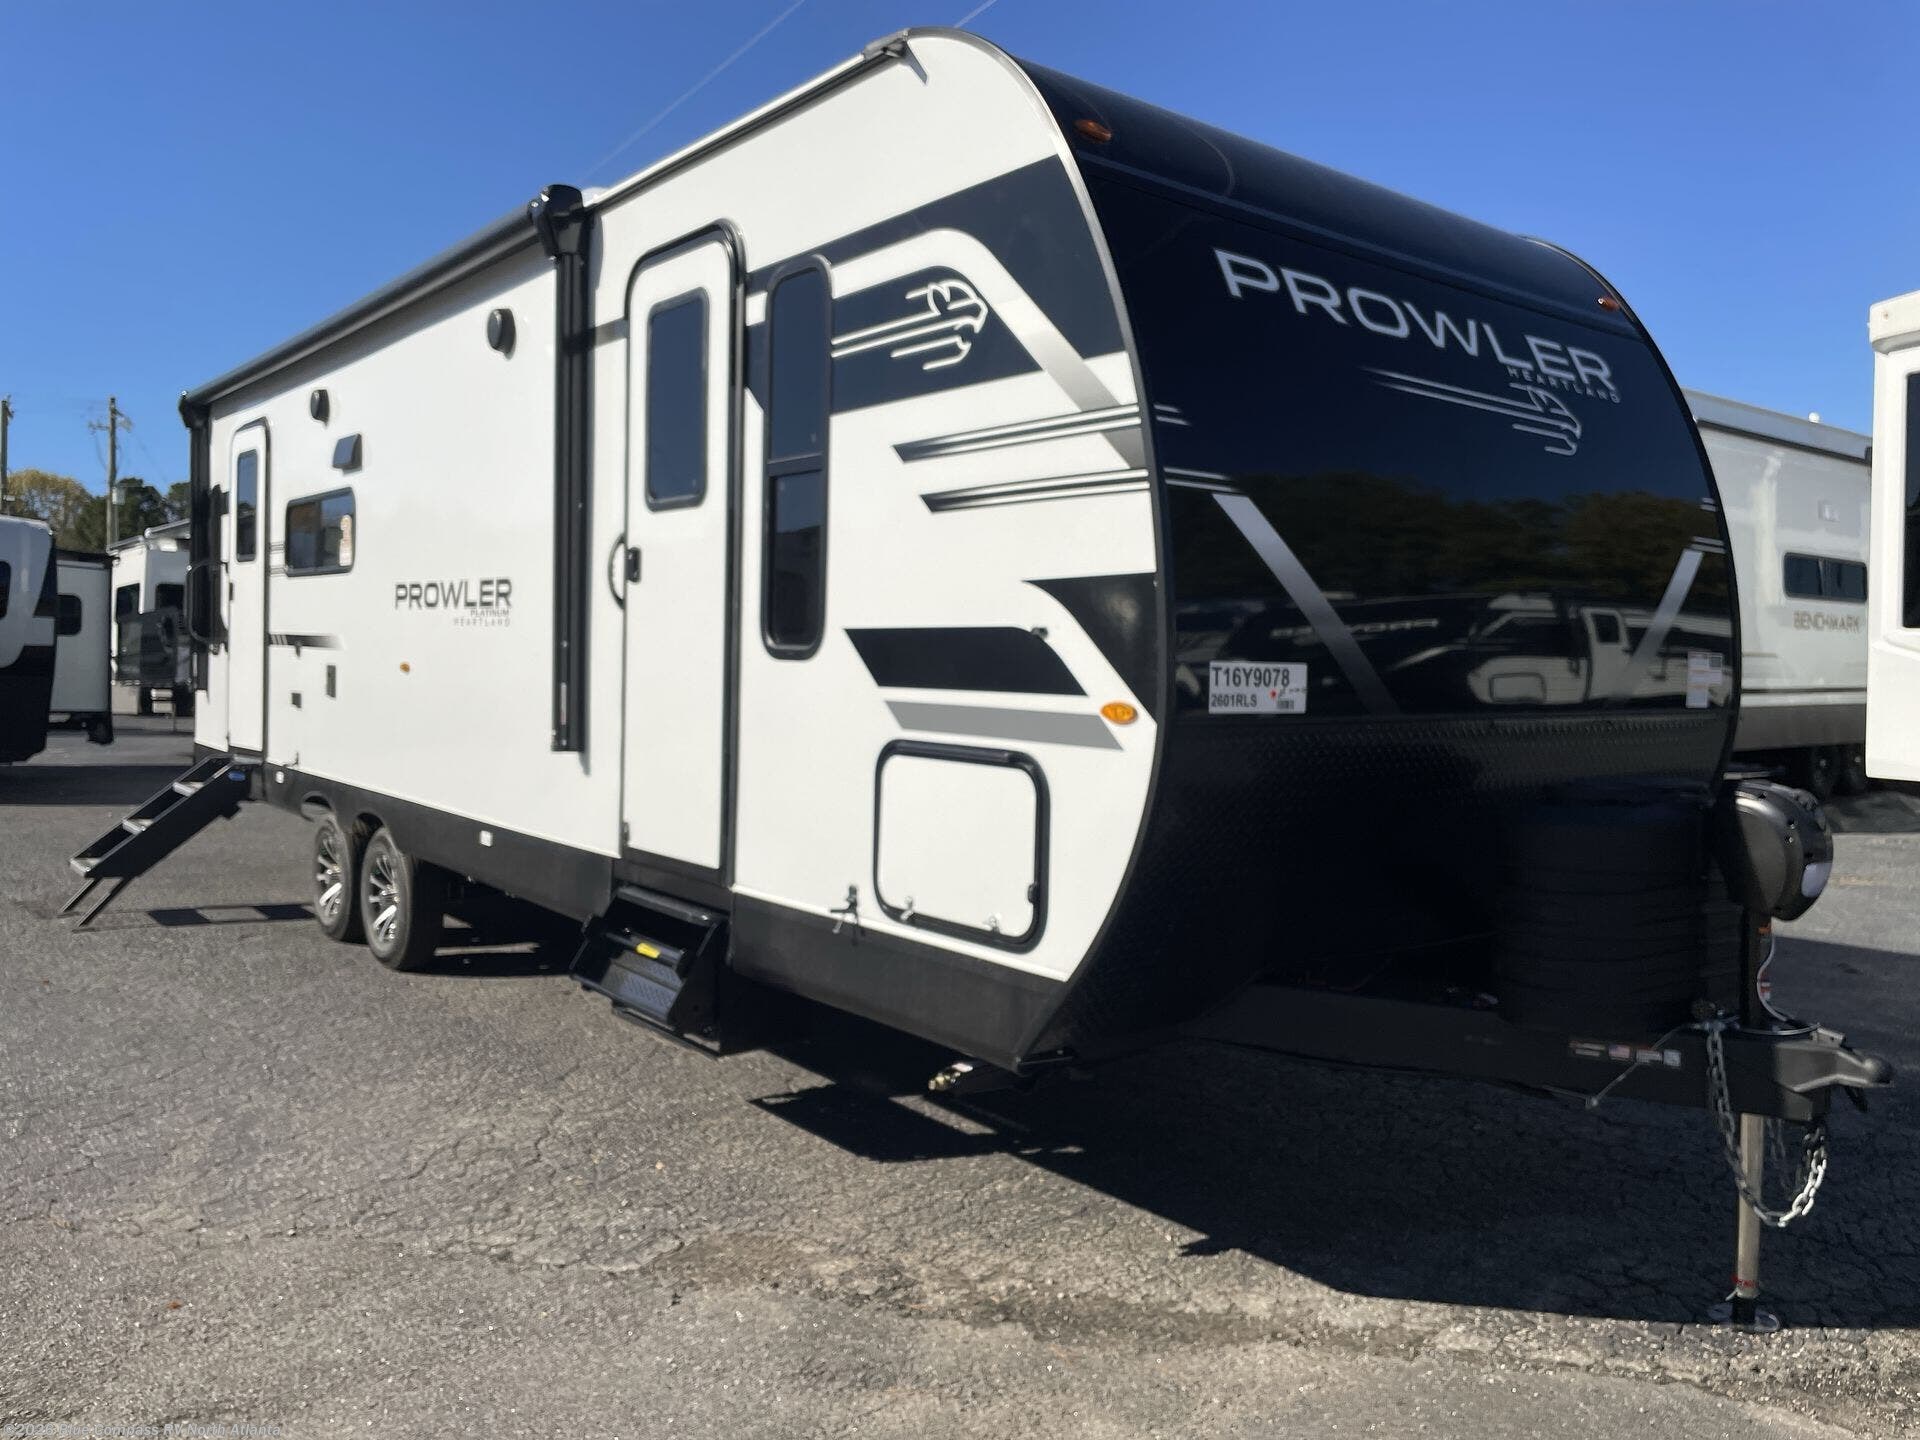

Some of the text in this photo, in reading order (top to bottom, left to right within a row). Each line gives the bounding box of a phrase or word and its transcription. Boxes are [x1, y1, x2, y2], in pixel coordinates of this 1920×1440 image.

[1213, 248, 1617, 392] PROWLER
[1506, 365, 1622, 404] HEARTLAND
[394, 578, 513, 609] PROWLER
[453, 617, 511, 627] HEARTLAND
[470, 609, 510, 617] PLATINUM
[1792, 610, 1861, 634] BENCHMARK
[1211, 666, 1291, 687] T16Y9078
[1210, 693, 1258, 708] 2601RLS
